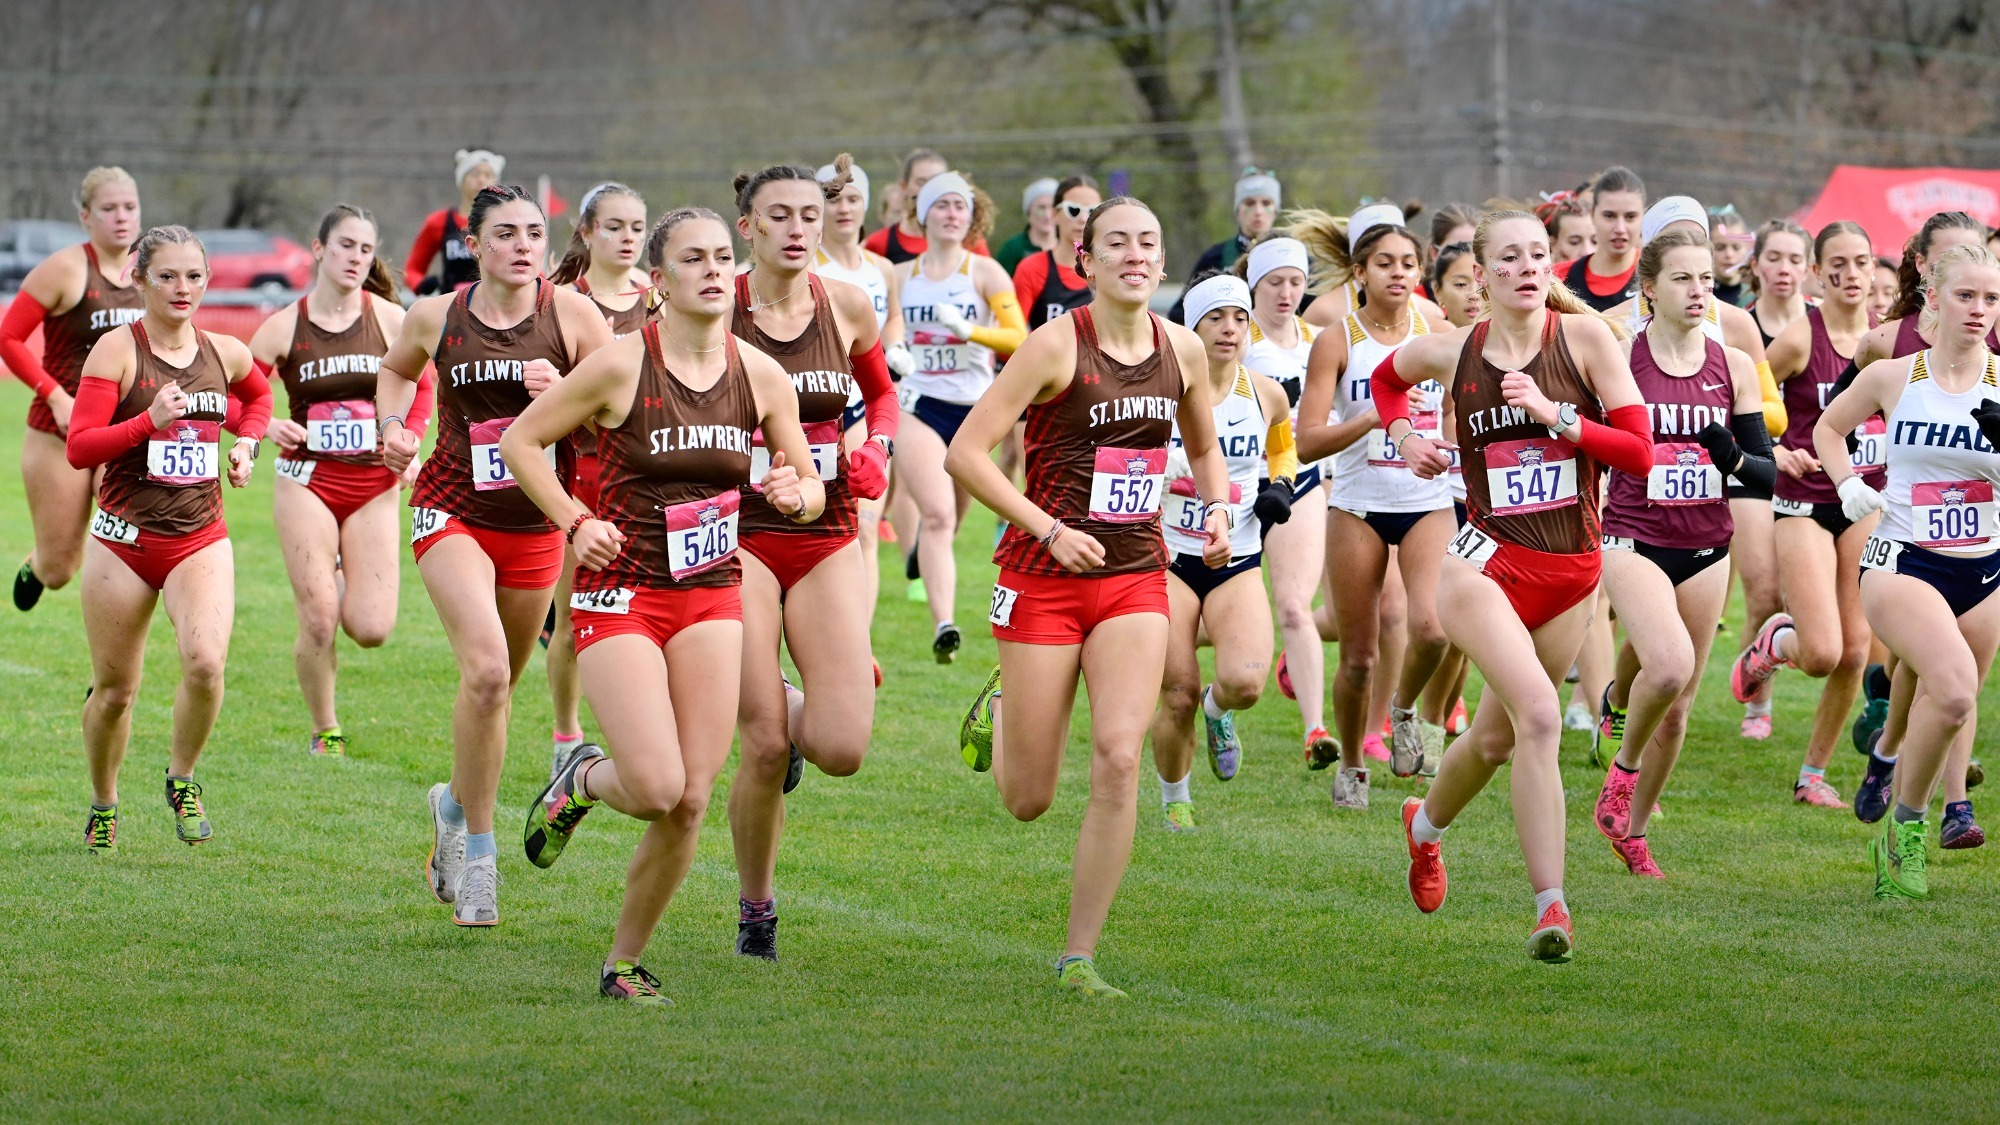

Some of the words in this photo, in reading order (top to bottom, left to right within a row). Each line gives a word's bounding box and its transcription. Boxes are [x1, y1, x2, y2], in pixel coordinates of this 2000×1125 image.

[90, 309, 109, 330] ST.
[299, 361, 317, 383] ST.
[319, 354, 383, 377] LAWRENC
[451, 363, 471, 388] ST.
[475, 360, 530, 382] LAWR
[923, 348, 957, 371] 513
[186, 391, 228, 417] WRENC
[1089, 401, 1111, 428] ST.
[1113, 396, 1178, 423] LAWRENC
[321, 424, 363, 450] 550
[1468, 410, 1489, 437] ST.
[1894, 420, 1999, 455] ITHAC
[650, 427, 675, 455] ST.
[1853, 438, 1876, 466] 60
[162, 445, 206, 477] 553
[1107, 478, 1153, 513] 552
[1506, 465, 1561, 506] 547
[1664, 468, 1709, 499] 561
[1180, 500, 1207, 531] 51
[1928, 506, 1979, 541] 509
[684, 521, 729, 567] 546
[1450, 527, 1487, 559] 47
